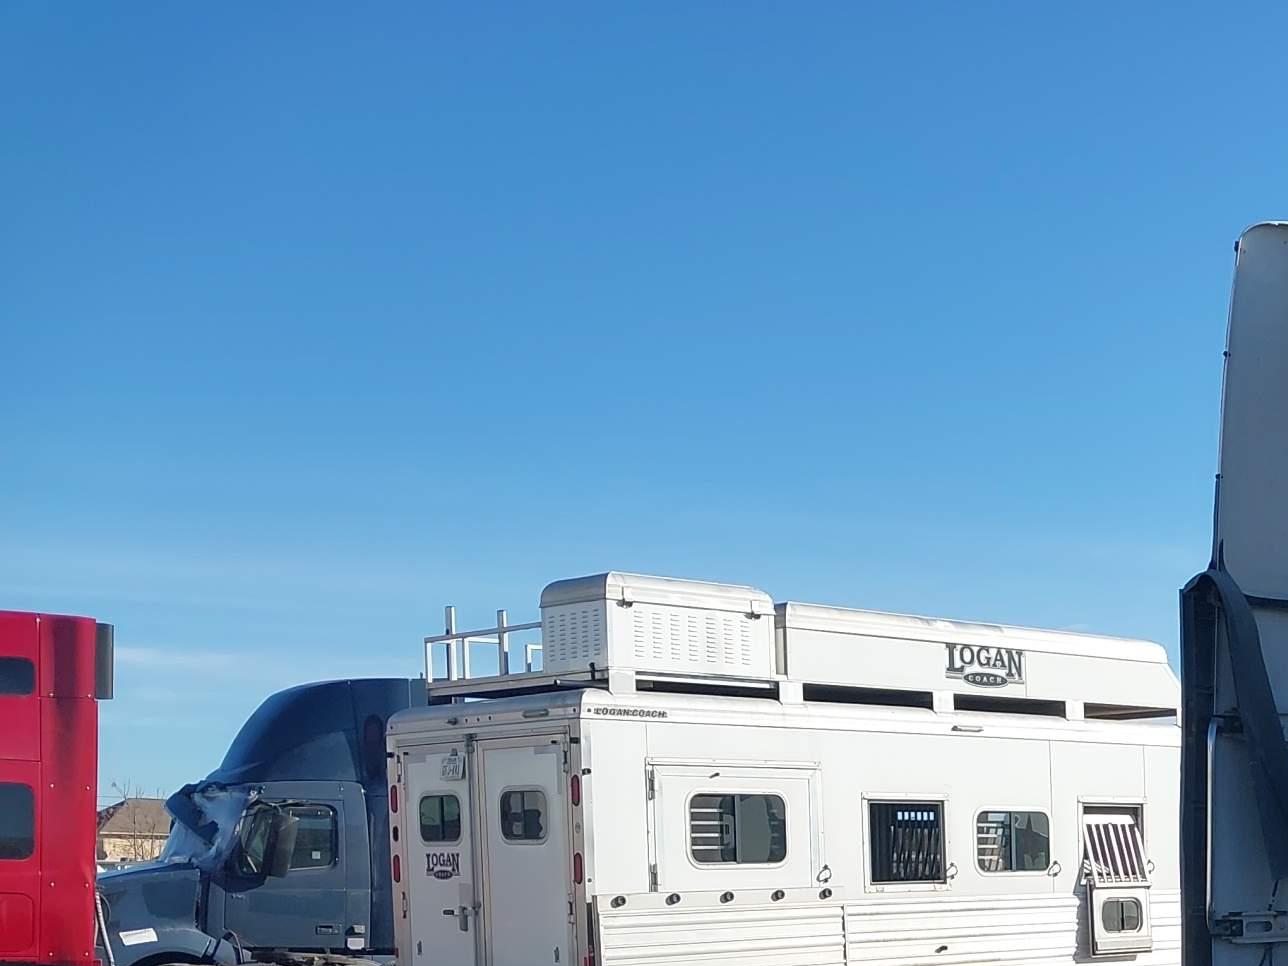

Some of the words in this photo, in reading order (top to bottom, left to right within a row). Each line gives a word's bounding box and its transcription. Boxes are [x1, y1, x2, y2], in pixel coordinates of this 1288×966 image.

[945, 643, 1023, 681] LOGAN
[968, 674, 1003, 684] COACH
[594, 707, 631, 717] LOGAN
[632, 709, 667, 719] COACH
[426, 853, 460, 874] LOGAN
